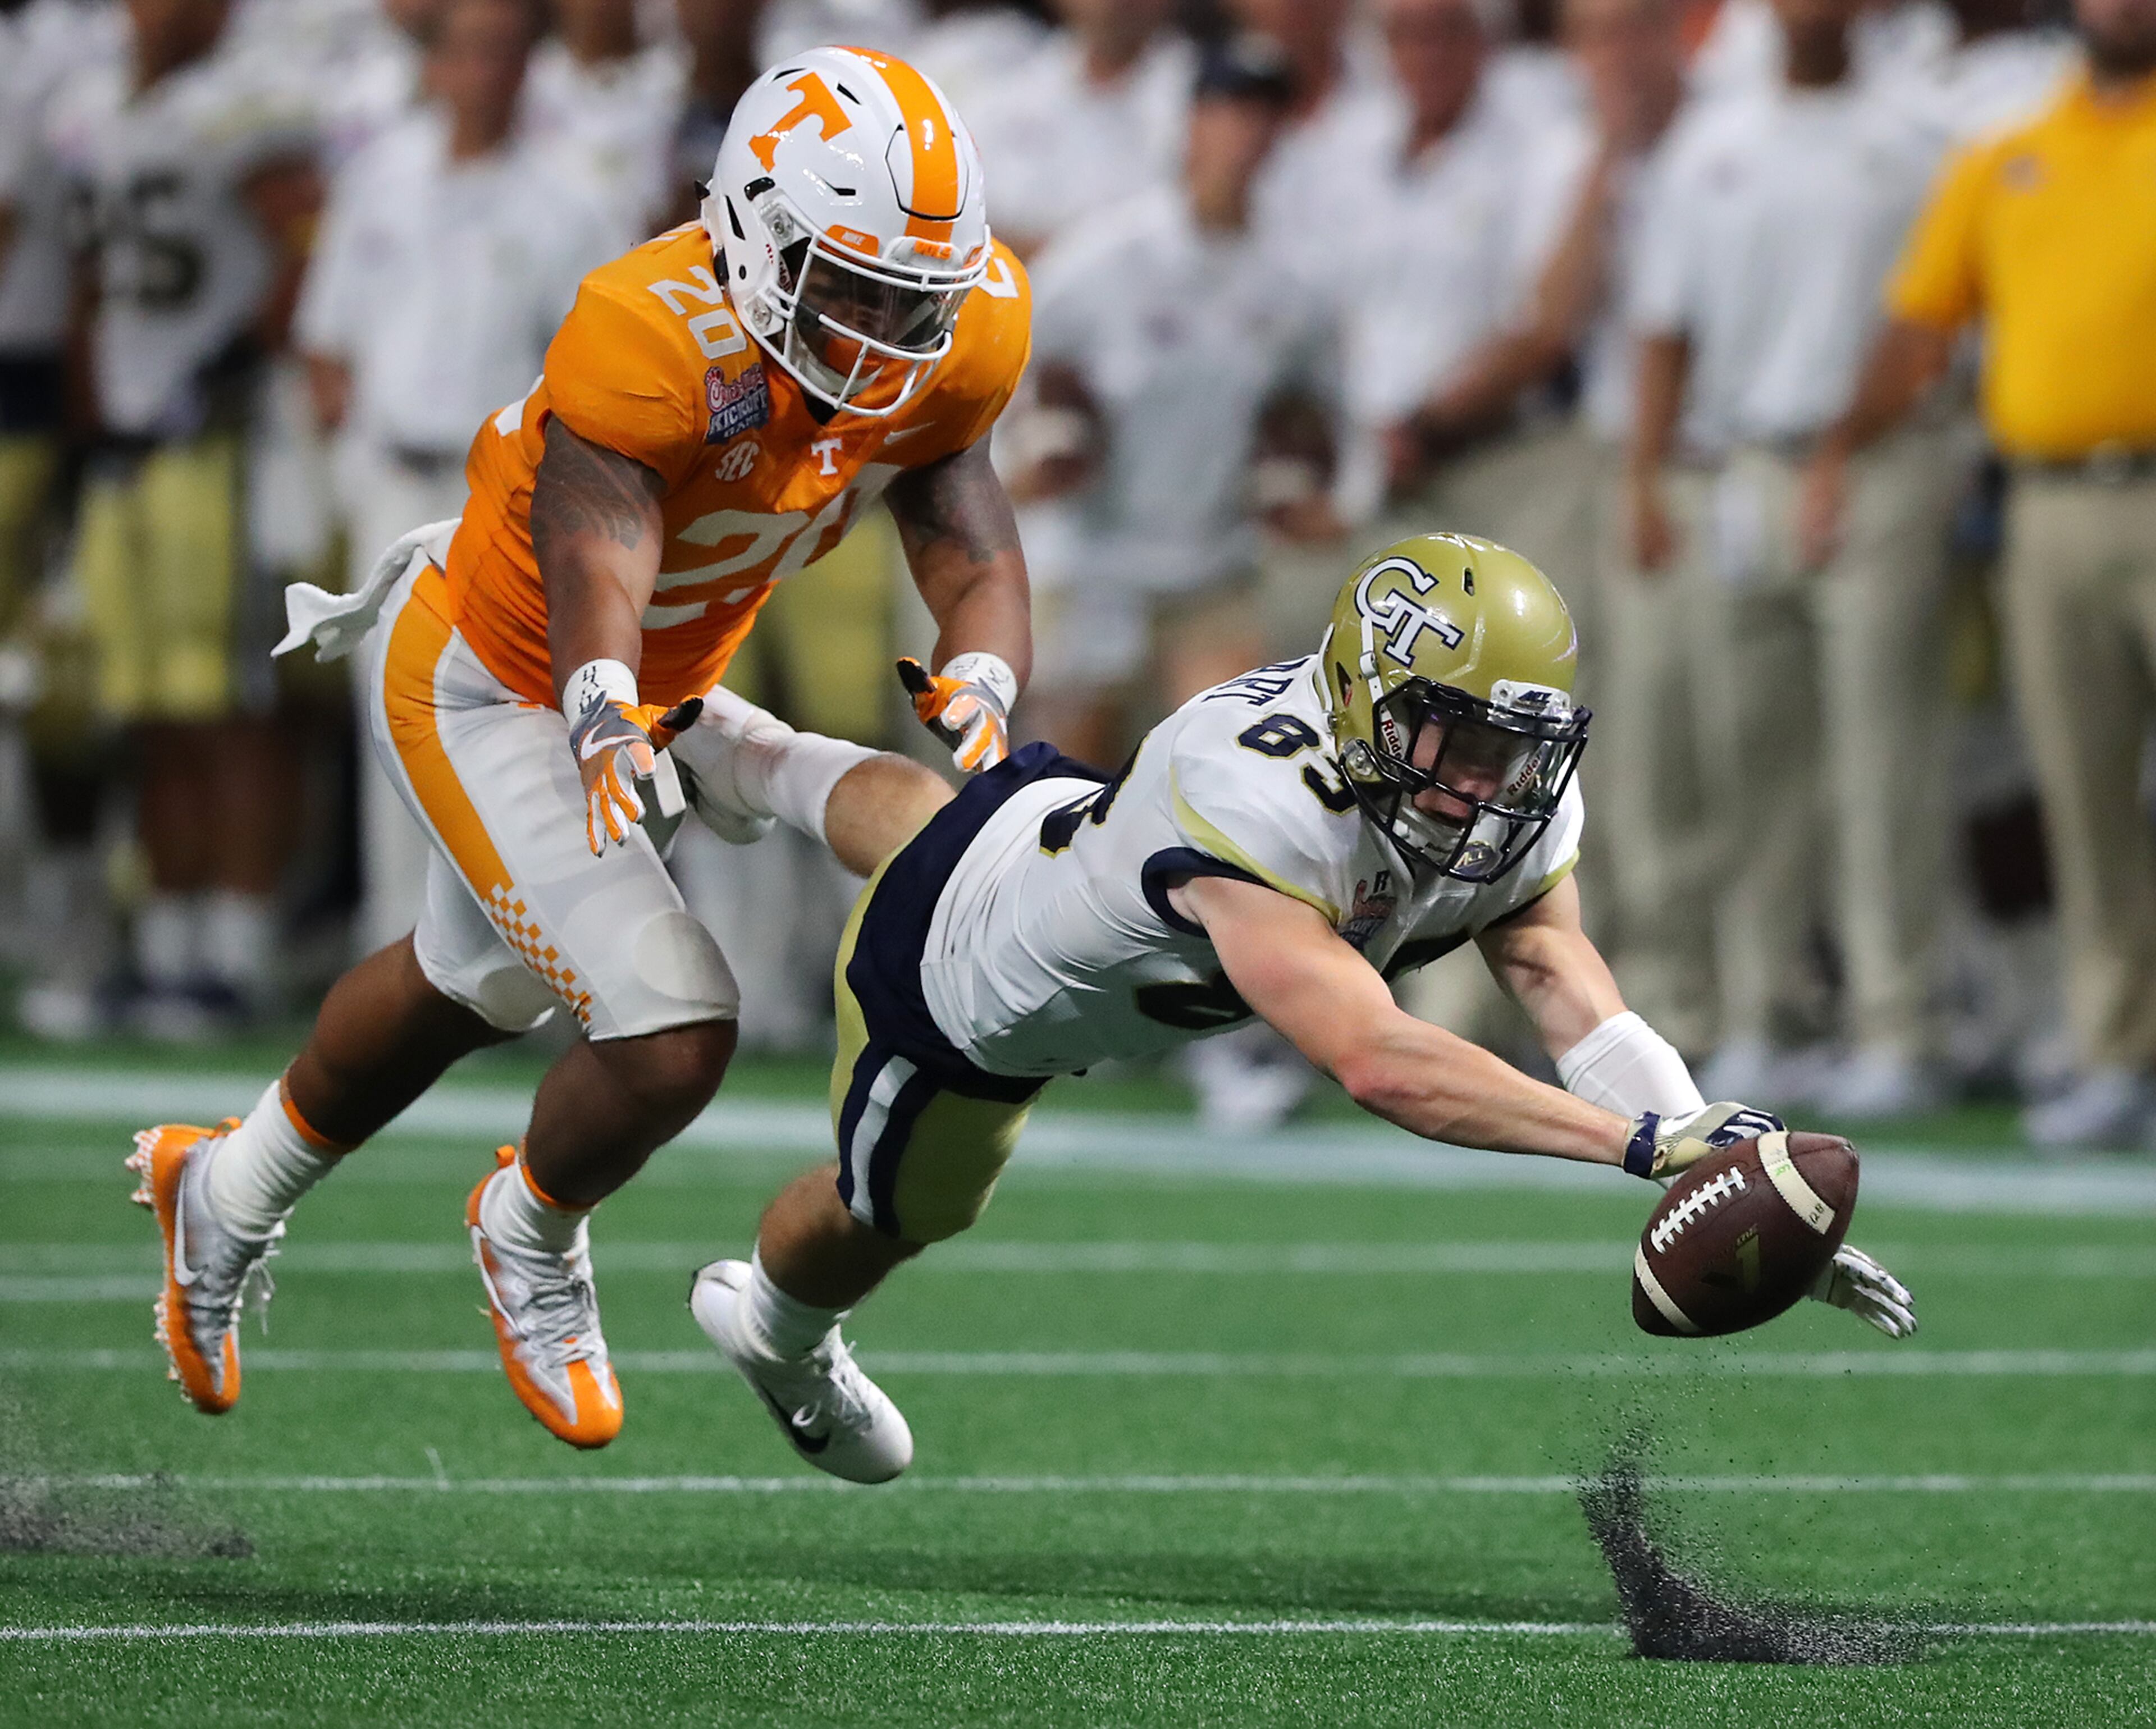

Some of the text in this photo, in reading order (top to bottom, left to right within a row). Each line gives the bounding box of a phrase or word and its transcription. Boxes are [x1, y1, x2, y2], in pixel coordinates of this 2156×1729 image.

[748, 71, 853, 173] T
[646, 265, 747, 360] 20
[811, 438, 842, 476] T
[1354, 556, 1465, 668] GT
[1234, 713, 1360, 817] 83
[1381, 719, 1403, 759] Ridde
[1507, 750, 1543, 796] Ridde
